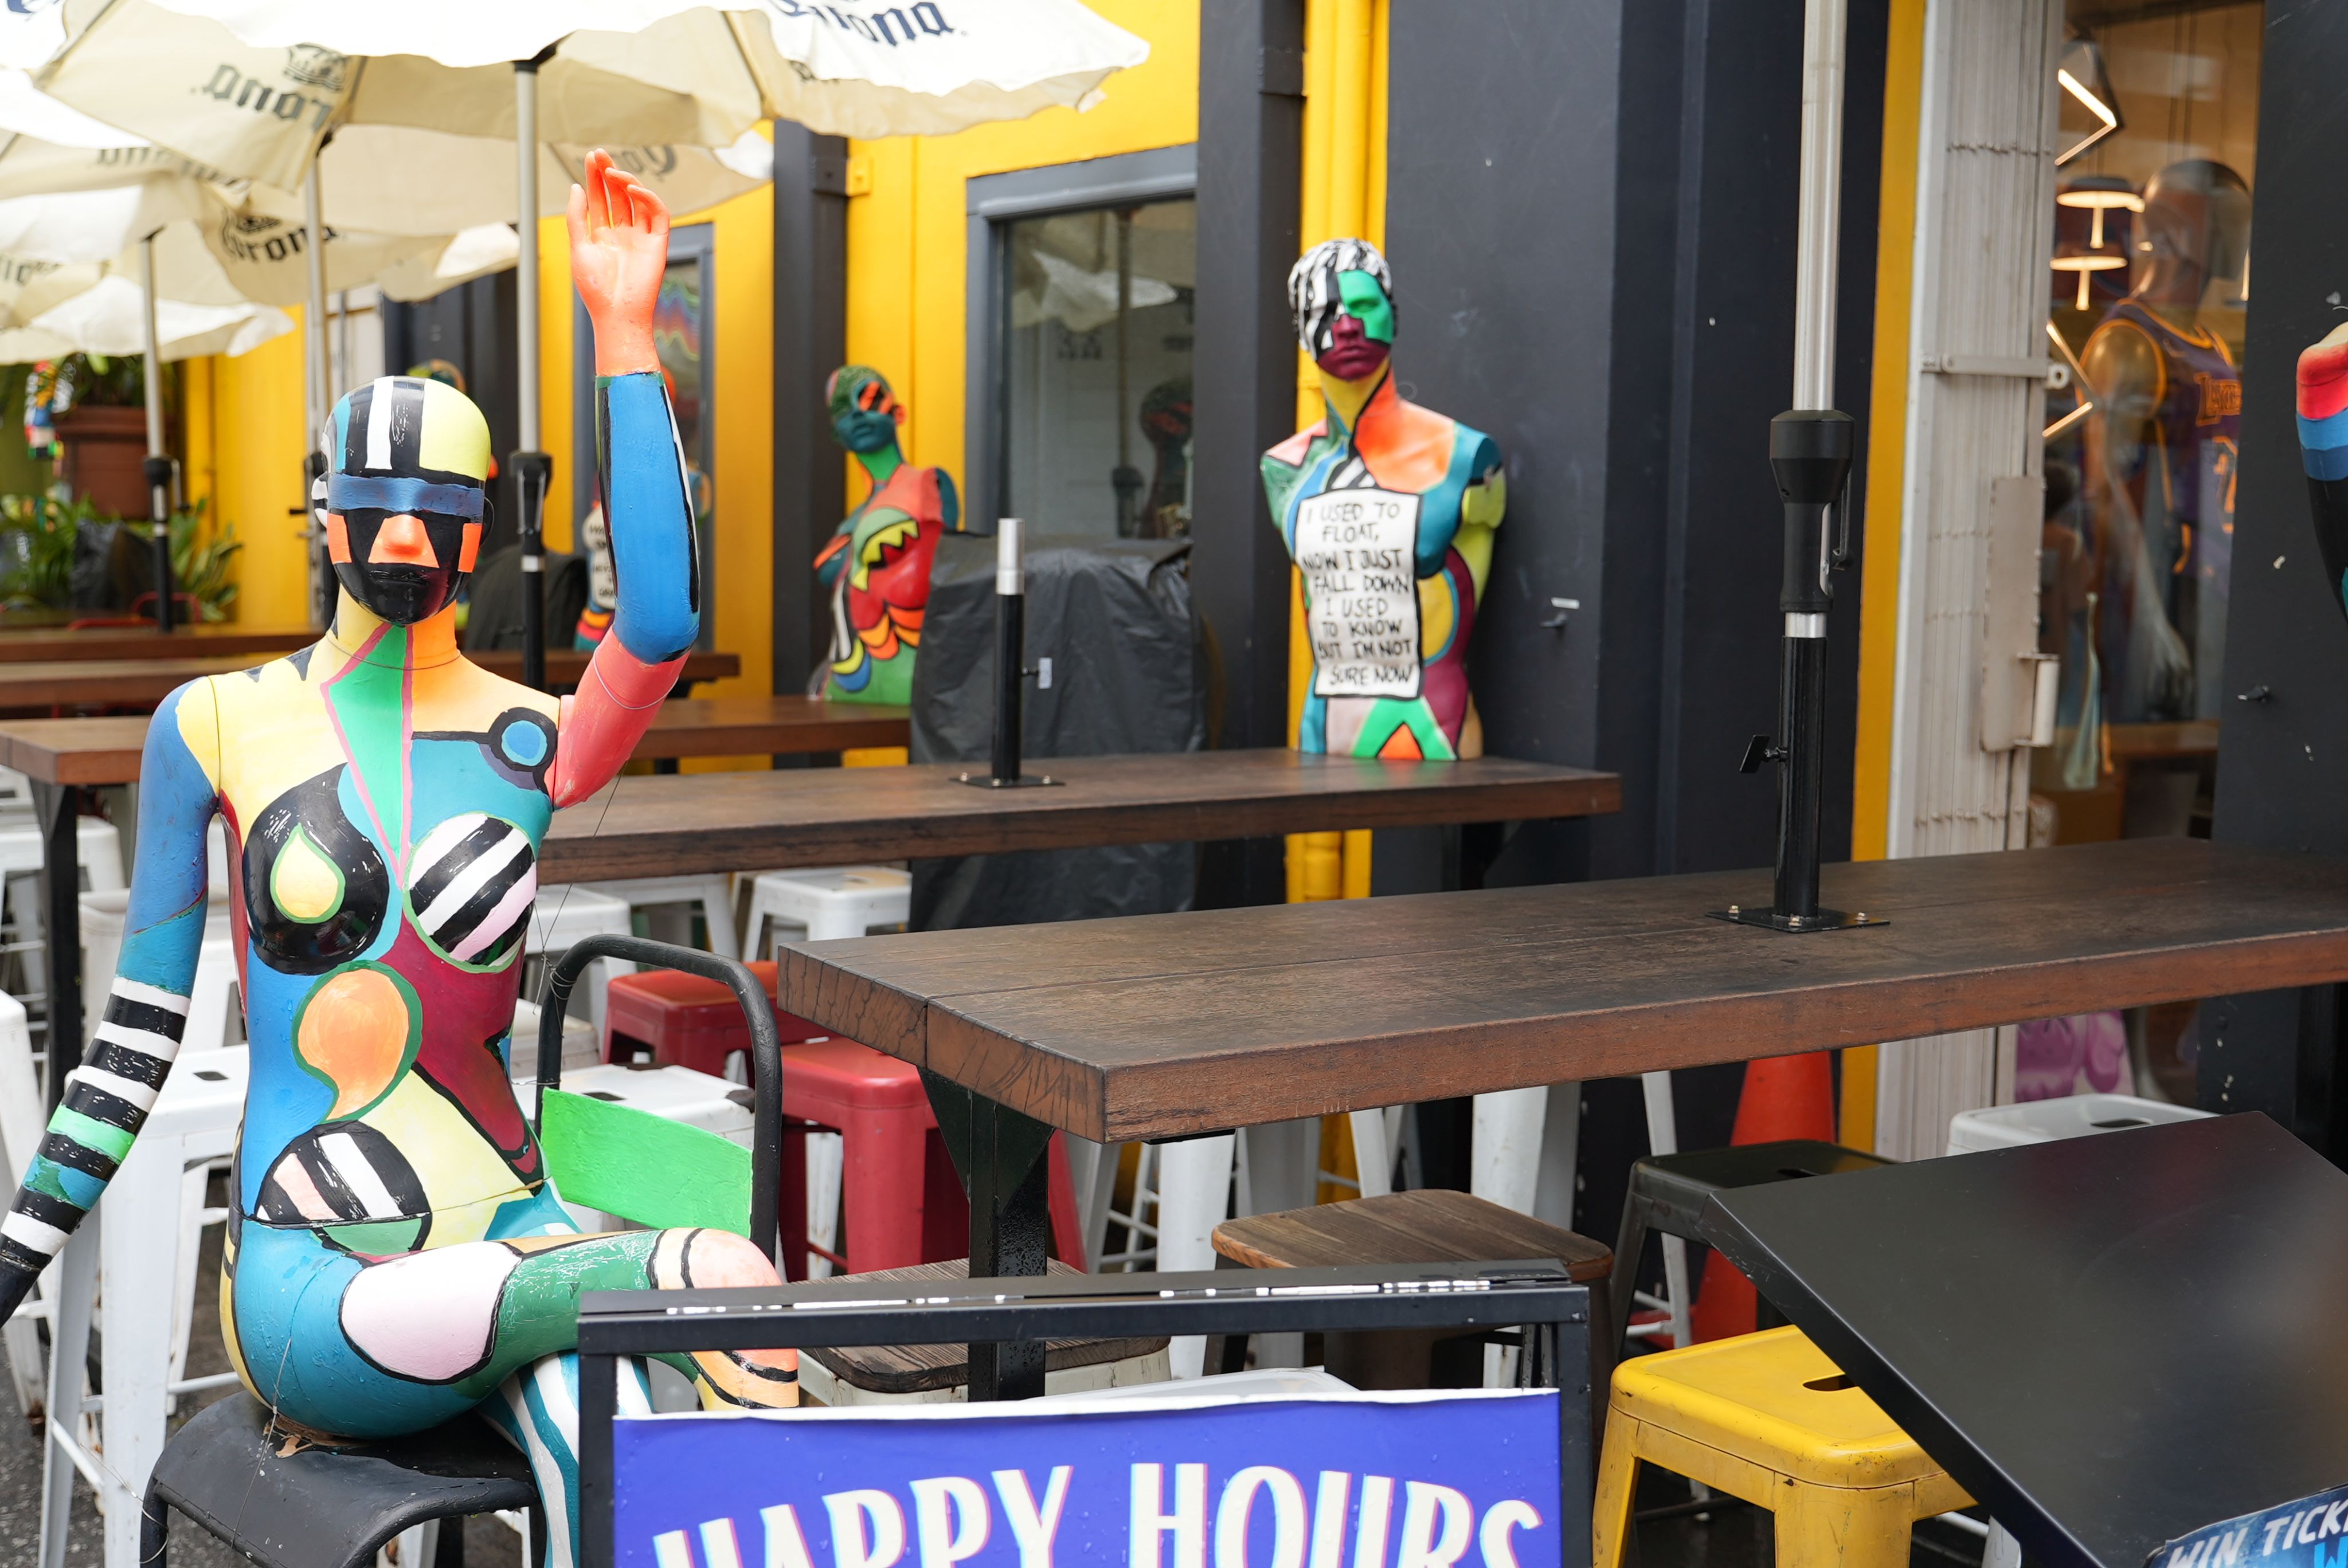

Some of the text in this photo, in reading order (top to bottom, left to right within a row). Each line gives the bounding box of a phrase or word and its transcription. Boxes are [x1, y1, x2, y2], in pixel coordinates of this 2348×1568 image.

[1307, 503, 1400, 524] I USED TO
[1322, 523, 1379, 542] FLOAT,
[1302, 549, 1403, 571] NOW I JUST
[1314, 574, 1410, 594] FALL DOWN
[1325, 598, 1389, 618] I USED
[1322, 620, 1403, 638] TO KNOW
[1318, 641, 1343, 659] BUT
[1379, 638, 1413, 657] NOT
[1330, 664, 1414, 685] SURE NOW
[1129, 1463, 1543, 1568] HOURS
[2166, 1499, 2348, 1568] WIN TICK
